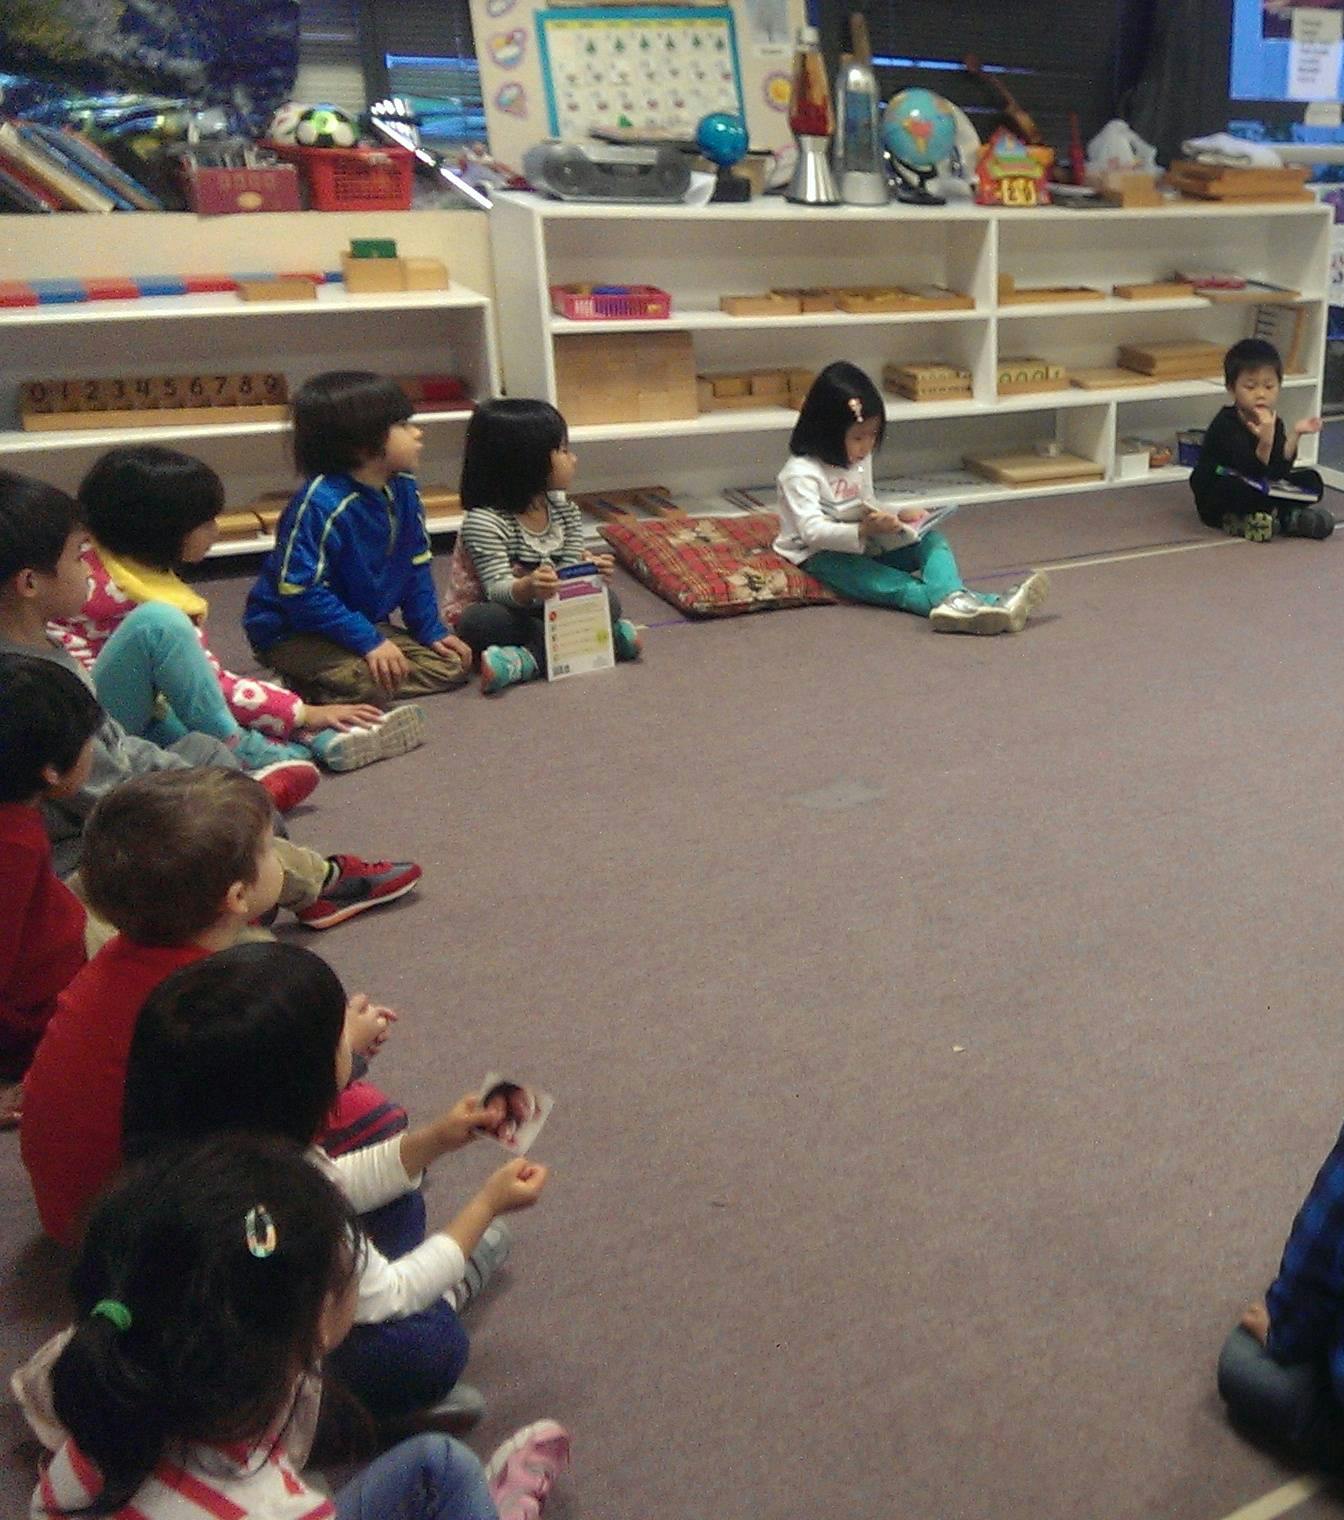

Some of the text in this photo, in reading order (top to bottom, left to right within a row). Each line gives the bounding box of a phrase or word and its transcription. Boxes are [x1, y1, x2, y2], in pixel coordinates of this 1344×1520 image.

[31, 374, 276, 402] 0 1 2 3 4 5 6 7 8 9
